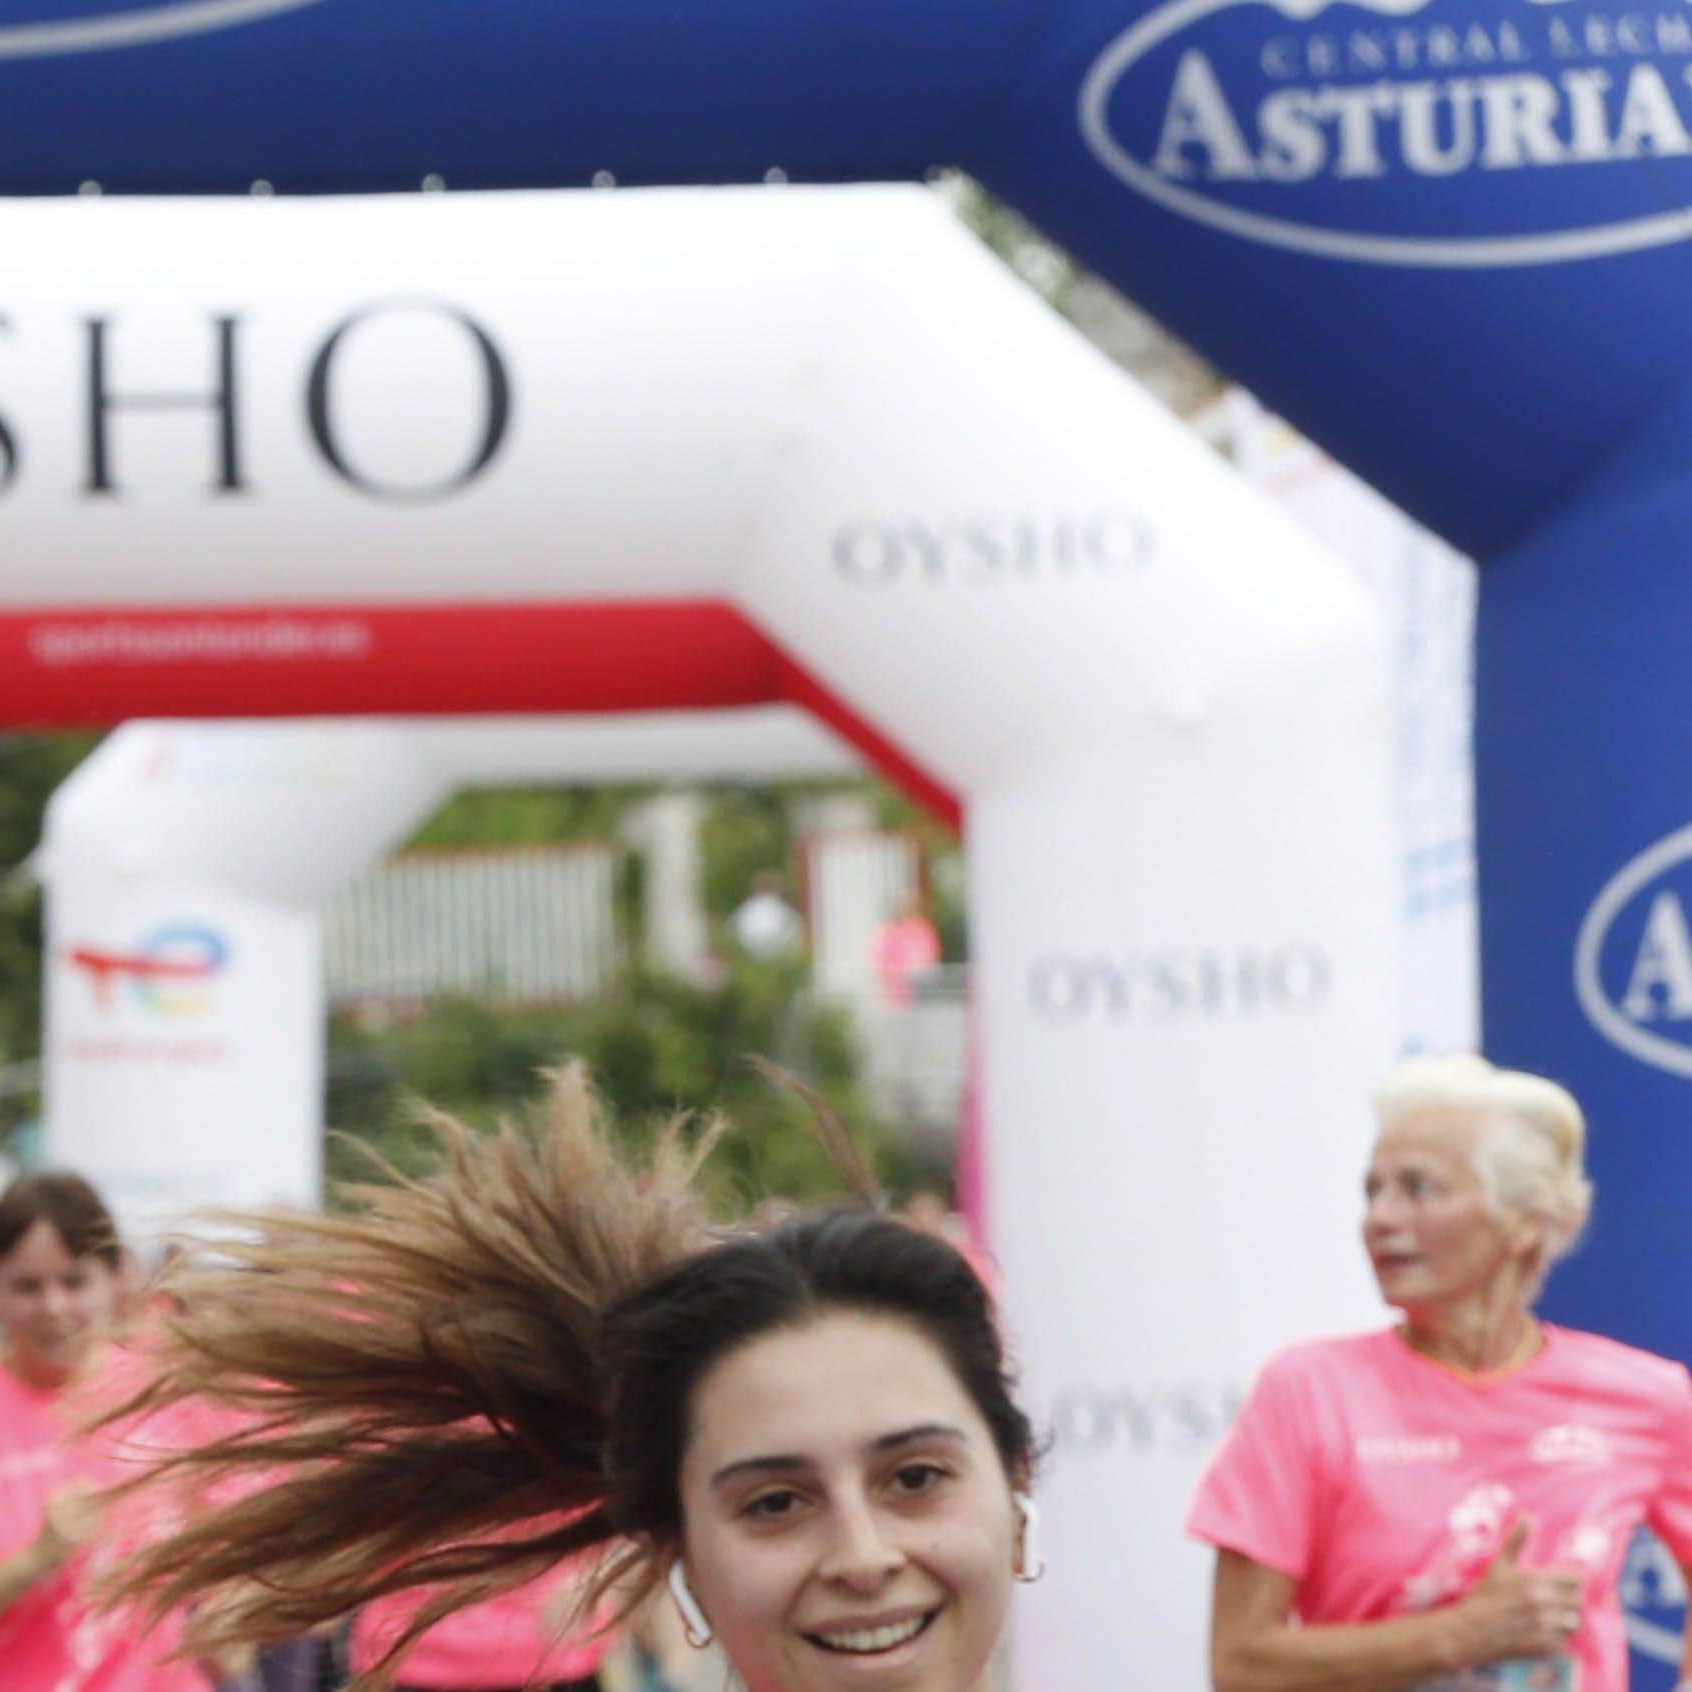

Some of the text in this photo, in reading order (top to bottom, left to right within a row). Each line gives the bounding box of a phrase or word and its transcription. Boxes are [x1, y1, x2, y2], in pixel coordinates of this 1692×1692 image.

[1260, 19, 1528, 79] CENTRAL
[1148, 47, 1692, 182] ASTURIA
[830, 504, 1160, 591] OYSHO
[1026, 942, 1336, 1030] OYSHO
